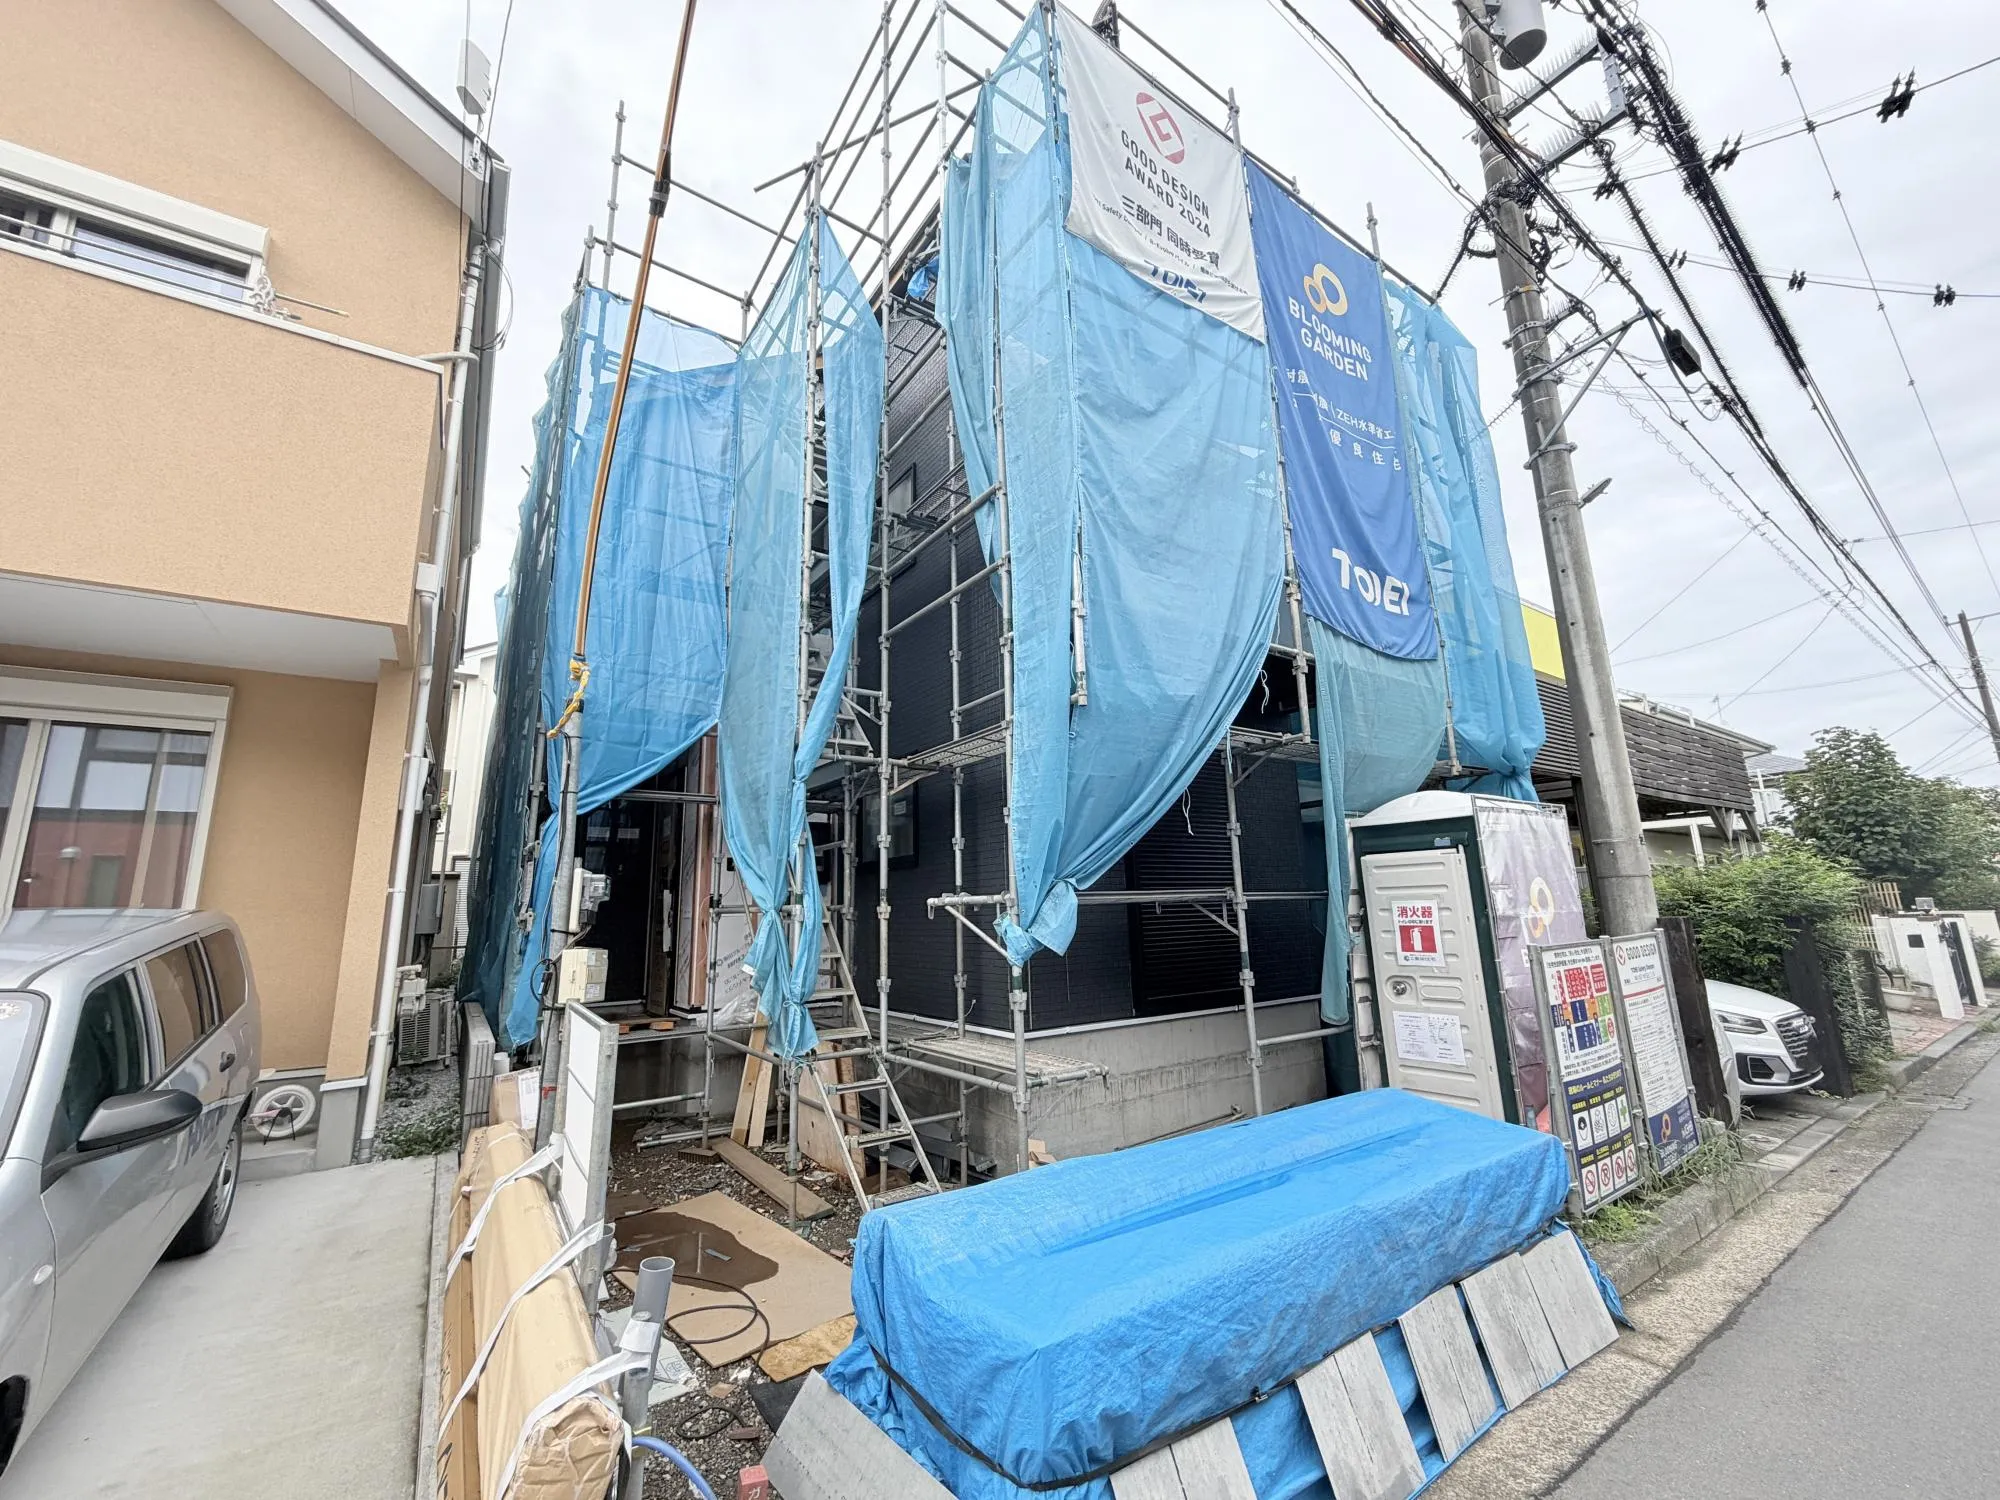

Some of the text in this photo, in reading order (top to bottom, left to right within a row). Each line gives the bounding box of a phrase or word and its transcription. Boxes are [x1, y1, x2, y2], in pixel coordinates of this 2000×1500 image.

[1121, 129, 1210, 220] GOOD DESIGN
[1125, 156, 1174, 209] AWARD
[1178, 202, 1211, 238] 2024
[1121, 194, 1163, 237] 三部門
[1289, 296, 1372, 363] BLOOMING
[1301, 327, 1369, 381] GARDEN
[1336, 408, 1396, 440] ZEH水準省エ
[1396, 904, 1433, 919] 消火器
